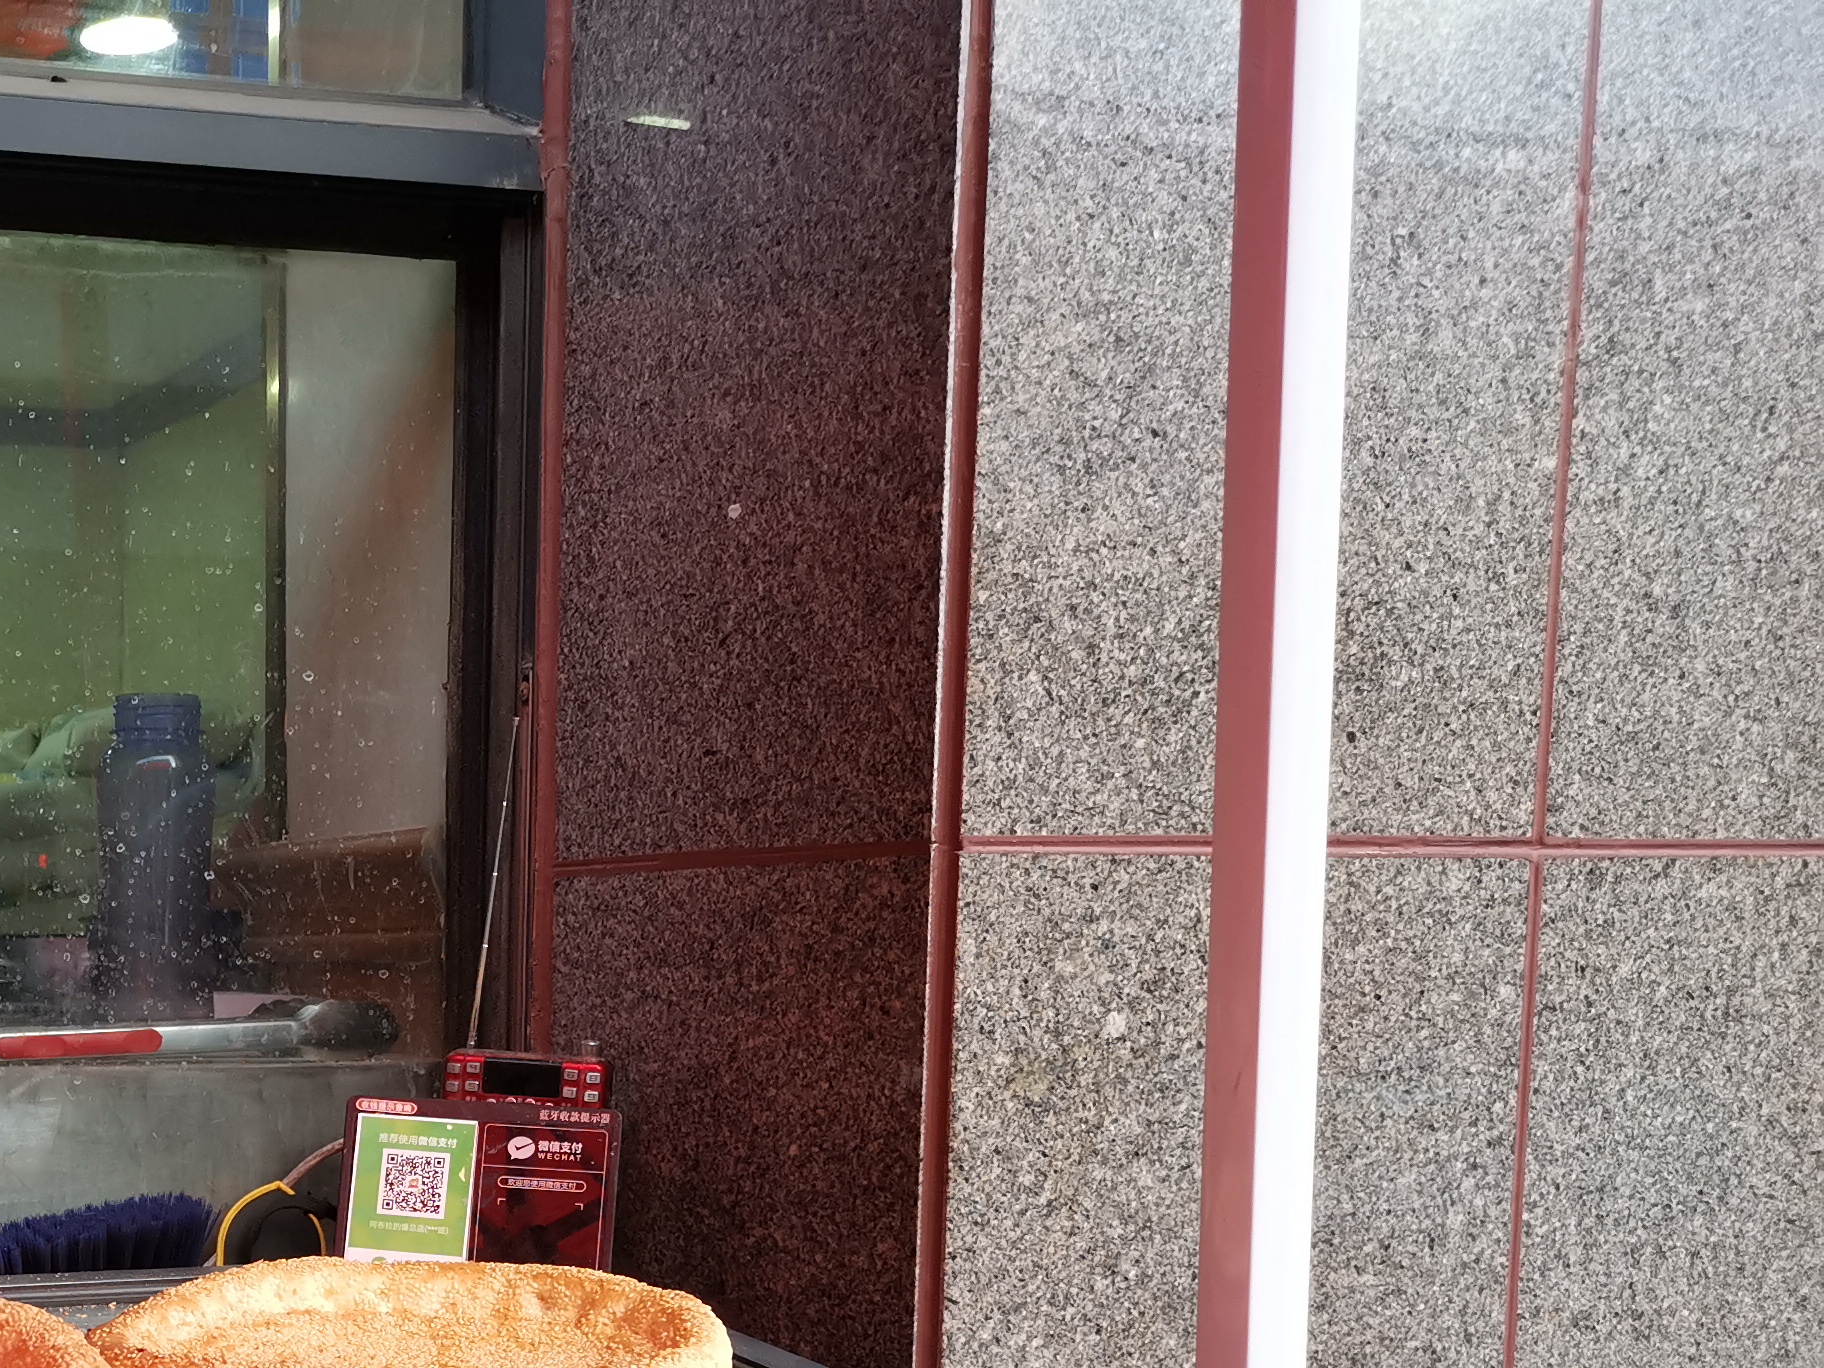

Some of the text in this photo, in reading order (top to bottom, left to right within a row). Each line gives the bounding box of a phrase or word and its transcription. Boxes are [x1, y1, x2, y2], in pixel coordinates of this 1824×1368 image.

[378, 1132, 458, 1149] 推荐使用微信支付
[537, 1140, 583, 1154] 微信支付
[537, 1152, 582, 1162] WECHAT
